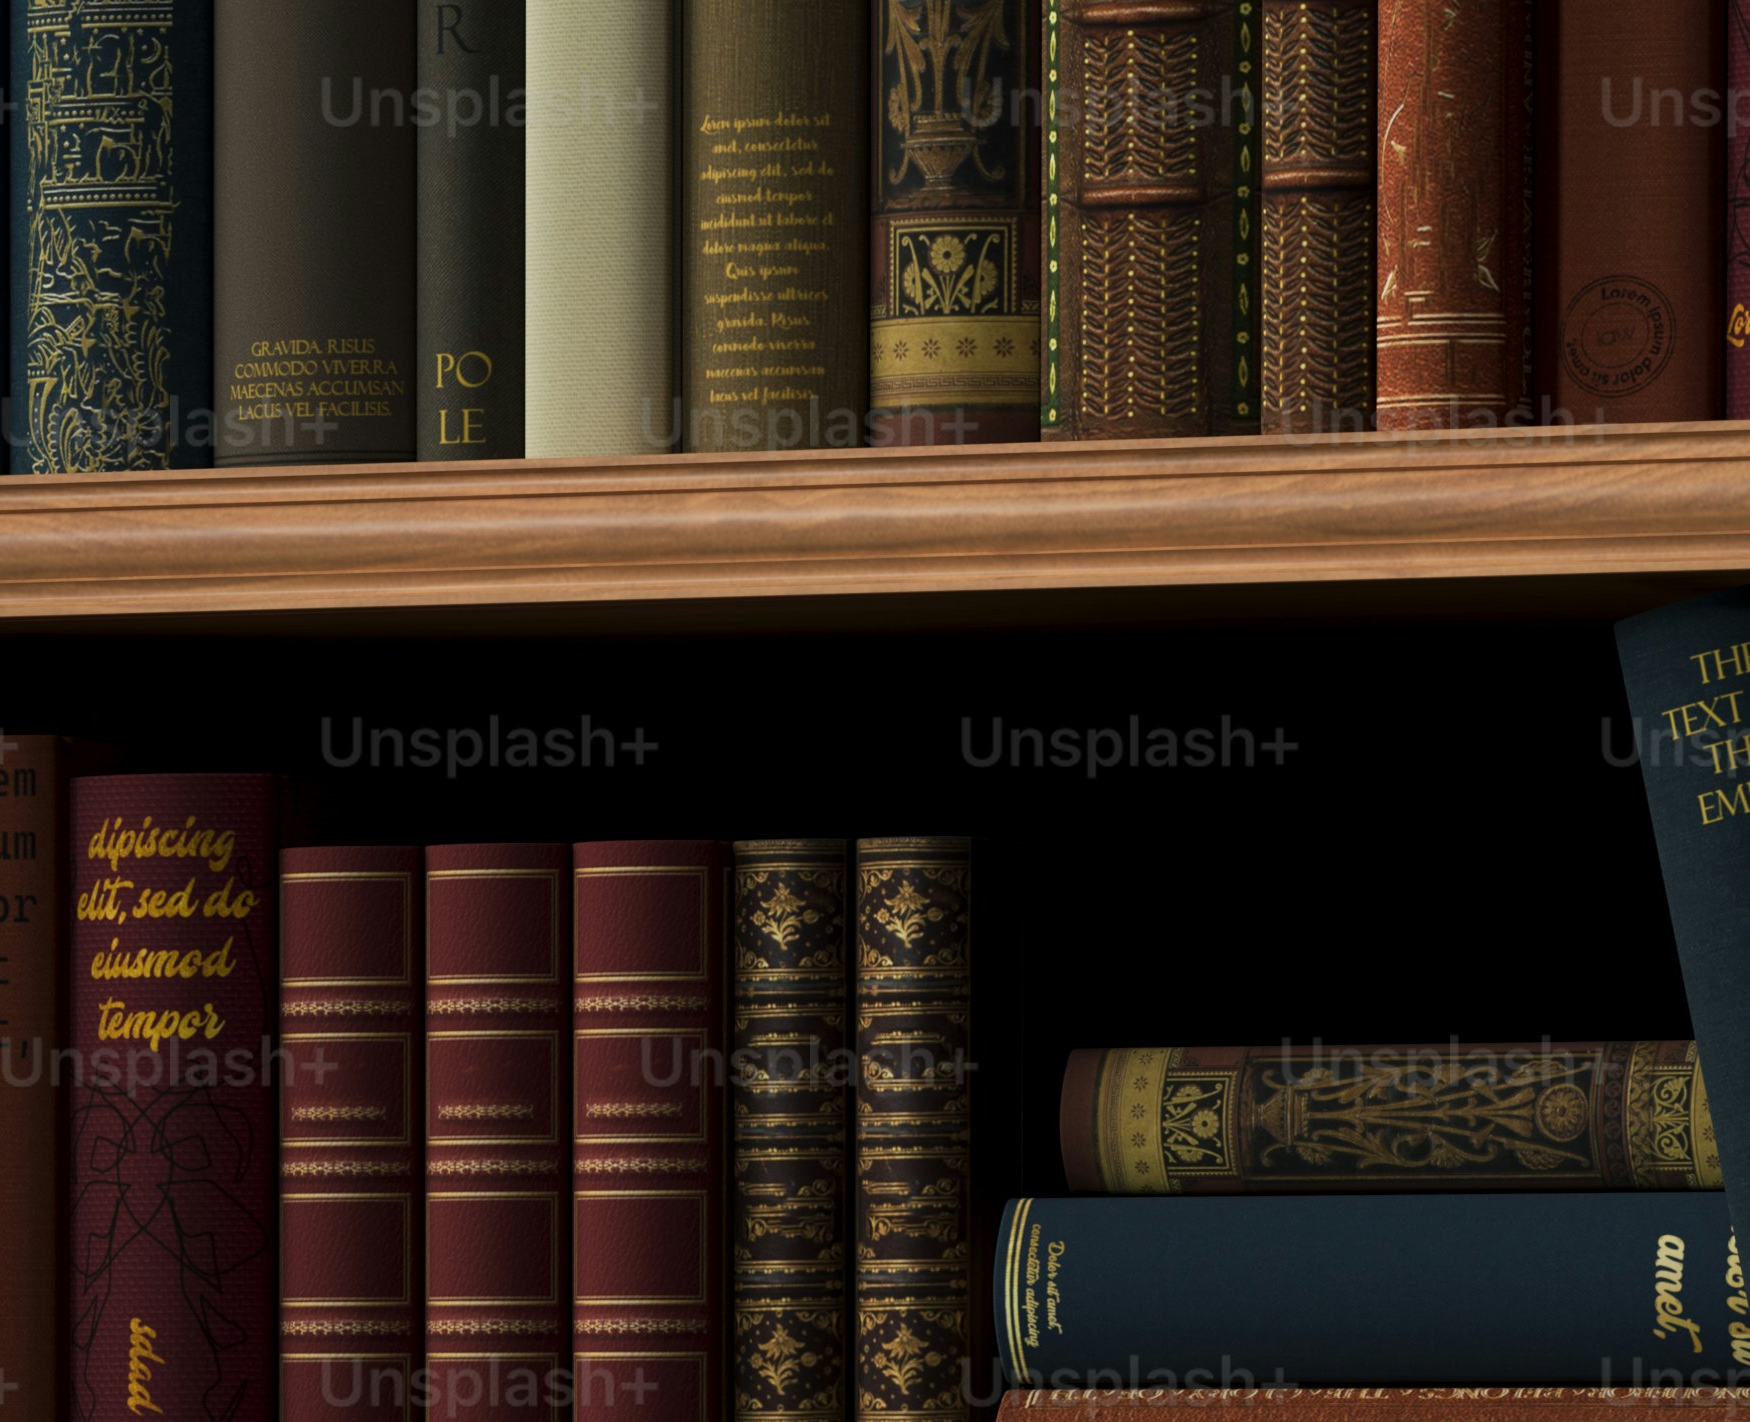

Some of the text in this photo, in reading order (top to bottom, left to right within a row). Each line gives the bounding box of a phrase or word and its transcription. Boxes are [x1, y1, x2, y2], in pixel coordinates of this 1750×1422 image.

[327, 338, 375, 354] RISUS
[235, 360, 398, 379] COMMODO VIVERRA
[435, 351, 494, 389] PO
[230, 381, 405, 401] MAECENAS ACCUMSAN
[238, 401, 392, 421] LACUS VEL FACILISIS.
[438, 407, 484, 447] LE
[1661, 689, 1745, 742] TEXT
[132, 876, 200, 918] sed
[202, 876, 261, 919] do
[91, 935, 238, 980] eiusmod
[98, 997, 227, 1053] tempor
[1652, 1233, 1704, 1354] amet,
[126, 1319, 166, 1414] sdad
